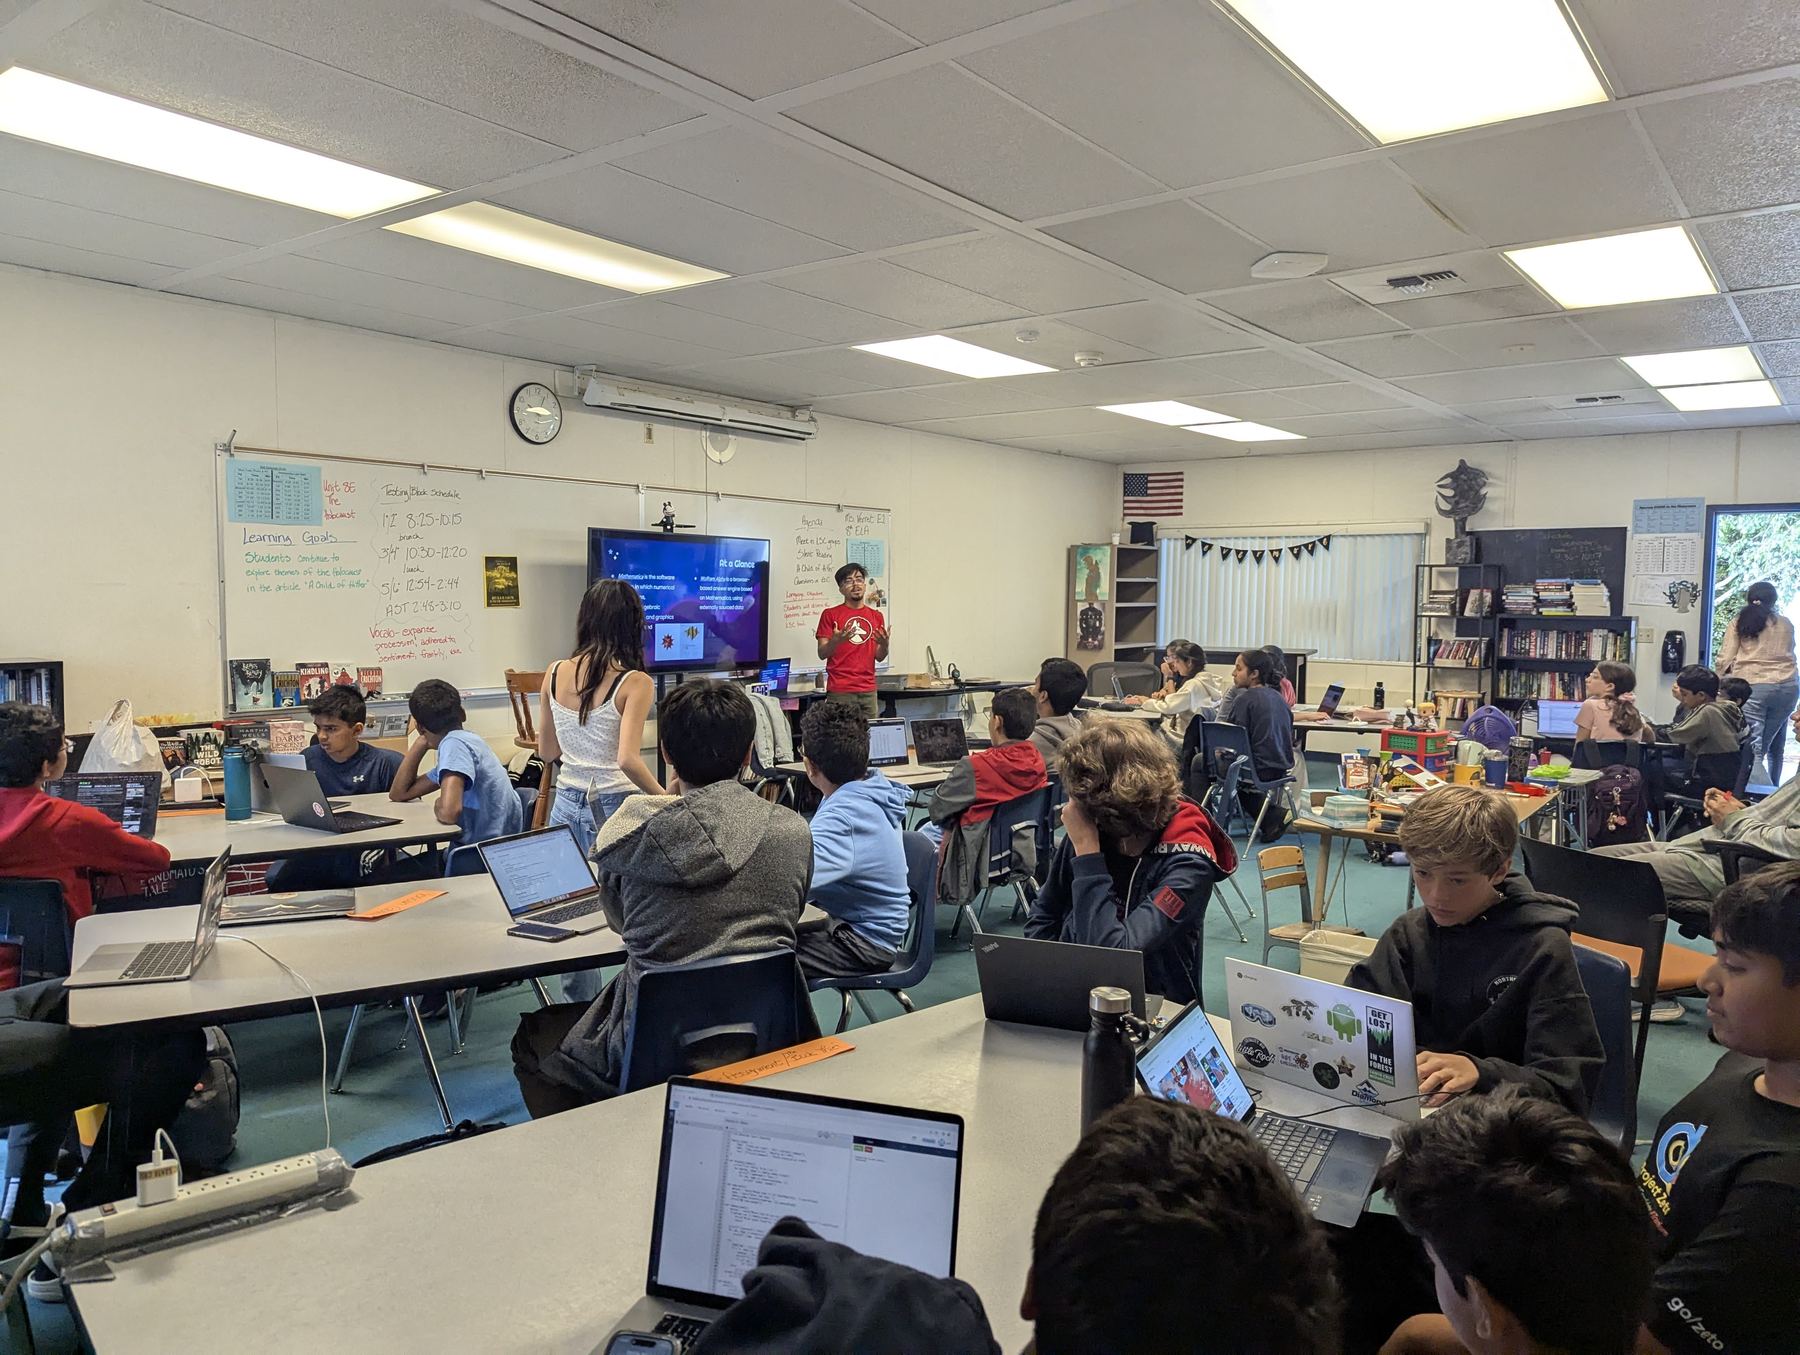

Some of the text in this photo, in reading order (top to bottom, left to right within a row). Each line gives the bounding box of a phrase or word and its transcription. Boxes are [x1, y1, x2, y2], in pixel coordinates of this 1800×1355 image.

[325, 493, 342, 506] The
[242, 527, 338, 546] Learning Goals
[398, 532, 425, 542] brunch
[245, 552, 340, 564] Students continue to
[720, 559, 728, 568] At
[734, 560, 755, 568] Glance
[316, 568, 330, 576] the
[403, 563, 425, 574] lunch
[247, 584, 256, 593] in
[260, 583, 272, 592] the
[275, 582, 301, 592] article
[200, 744, 216, 752] THE
[196, 750, 220, 759] WILD
[194, 758, 222, 766] ROBOT
[144, 882, 168, 897] TALE
[982, 942, 1000, 954] ThinkPad
[1494, 976, 1514, 986] NORTH
[1370, 1010, 1388, 1020] GET
[1369, 1017, 1391, 1030] LOST
[1370, 1052, 1393, 1066] IN THE
[1370, 1060, 1394, 1074] FOREST
[1352, 1090, 1386, 1106] Diamond
[1667, 1296, 1724, 1351] go/zeto
